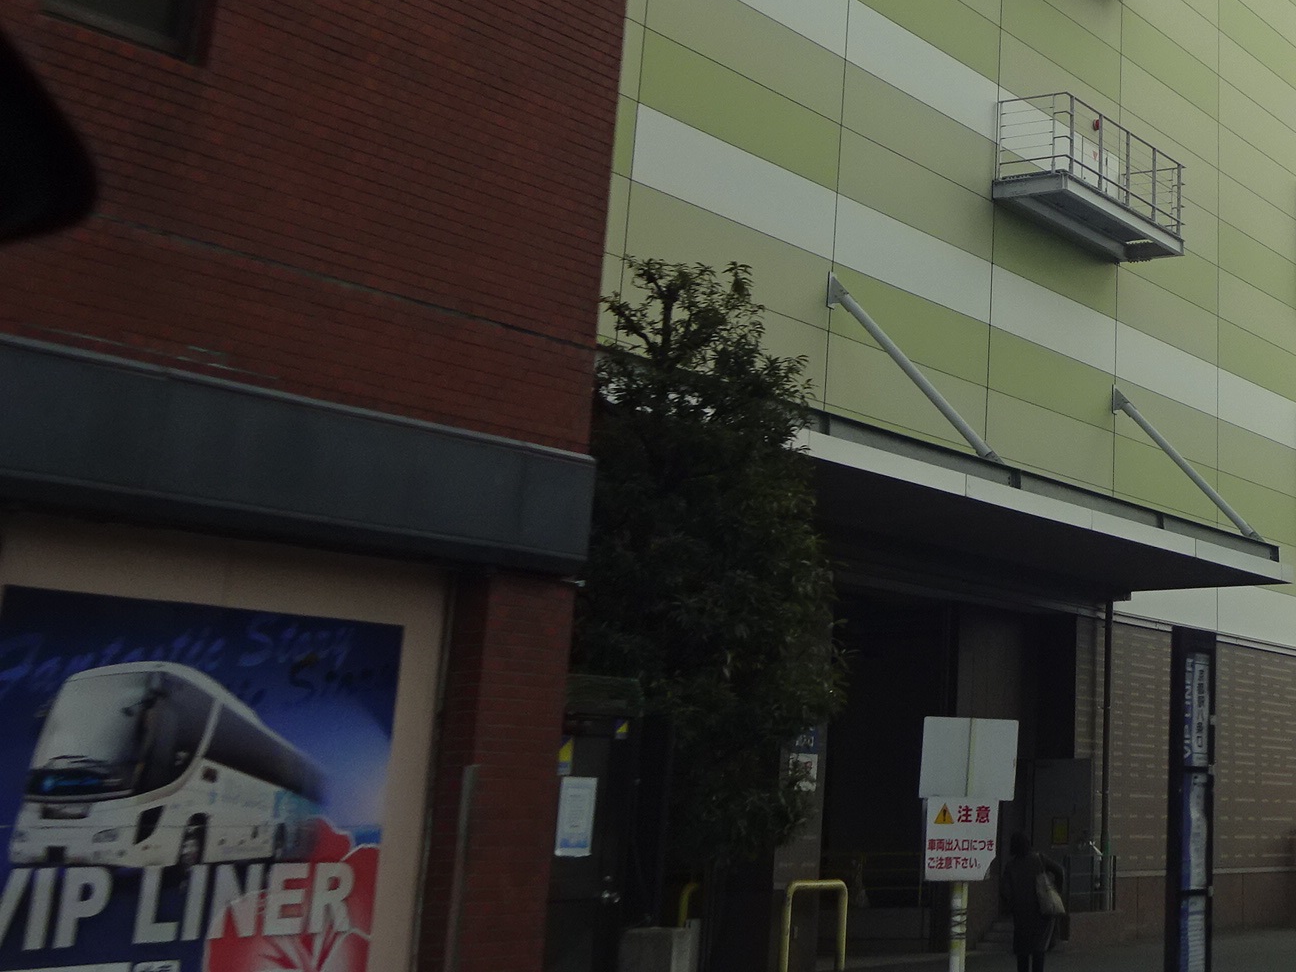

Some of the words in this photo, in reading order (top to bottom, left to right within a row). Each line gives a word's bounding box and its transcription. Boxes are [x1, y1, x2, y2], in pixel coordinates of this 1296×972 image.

[957, 805, 991, 823] 注意
[927, 839, 995, 852] 車両出入口につき
[133, 862, 356, 945] LINER
